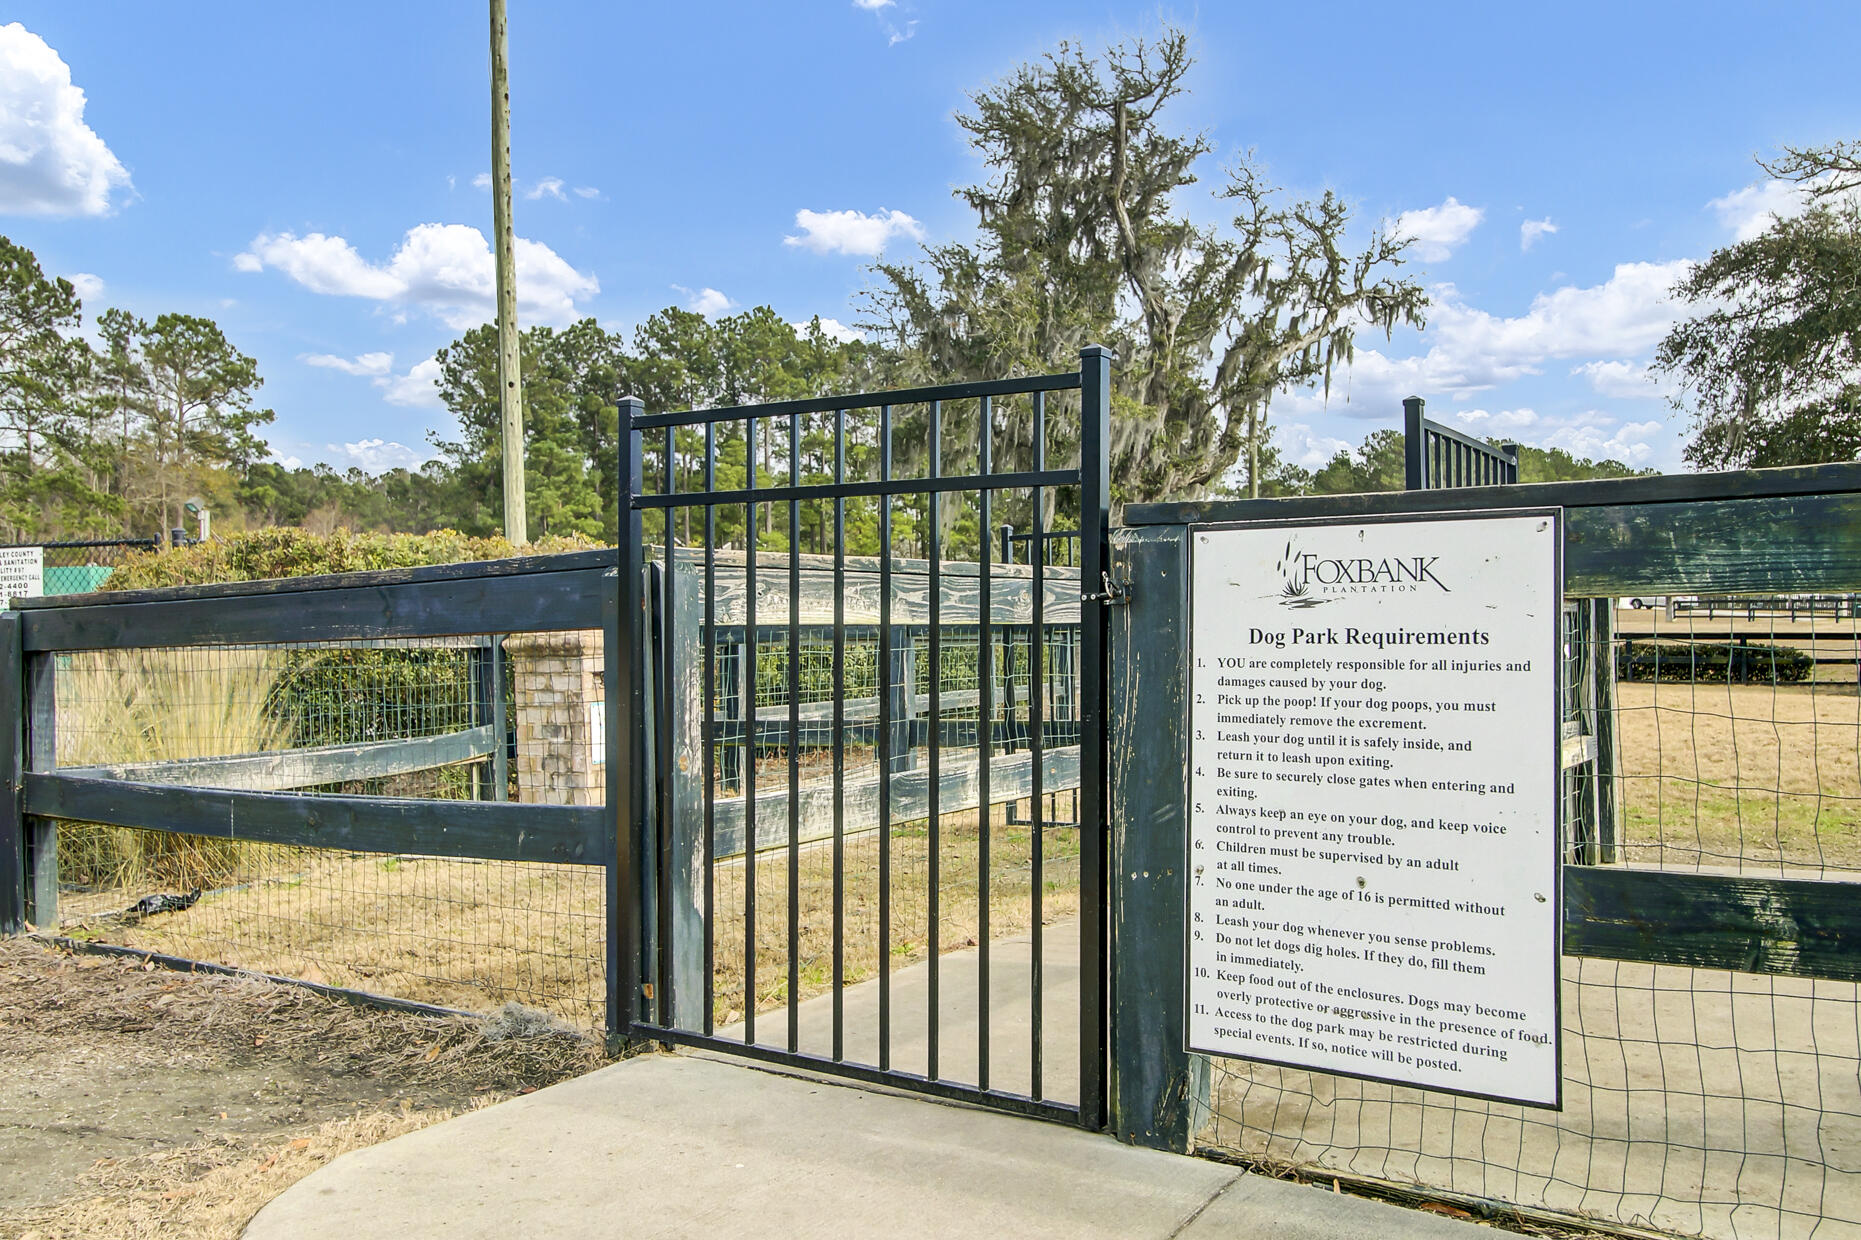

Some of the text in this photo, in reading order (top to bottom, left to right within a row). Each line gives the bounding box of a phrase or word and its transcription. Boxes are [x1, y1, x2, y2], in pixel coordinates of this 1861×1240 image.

[1302, 554, 1451, 592] FOXBANK
[1323, 584, 1417, 593] PLANTATION
[1248, 627, 1489, 650] Dog Park Requirements
[1198, 657, 1531, 674] 1. YOU are completely responsible for all injuries and
[1217, 676, 1387, 693] damages caused by your dog.
[1196, 693, 1496, 714] 2. Pick up the poop! If your dog poops, you must
[1217, 712, 1427, 730] immediately remove the excrement.
[1195, 729, 1472, 752] 3. Leash your dog until it is safely inside, and
[1217, 750, 1394, 771] return it to leash upon exiting.
[1195, 766, 1515, 796] 4. Be sure to securely close gates when entering and
[1216, 786, 1258, 801] exiting.
[1195, 802, 1507, 835] 5. Always keep an eye on your dog, and keep voice
[1216, 824, 1395, 846] control to prevent any trouble.
[1216, 840, 1459, 872] Children must be supervised by an adult
[1216, 860, 1282, 875] at all times.
[1194, 875, 1505, 916] 7. No one under the age of 16 is permitted without
[1215, 898, 1265, 911] an adult.
[1194, 911, 1496, 956] 8. Leash your dog whenever you sense problems.
[1194, 930, 1486, 975] 9. Do not let dogs dig holes. If they do, fill them
[1216, 950, 1304, 974] in immediately.
[1195, 967, 1527, 1021] 10. Keep food out of the enclosures. Dogs may become
[1195, 1003, 1508, 1062] 11. Access to the dog park may be restricted during
